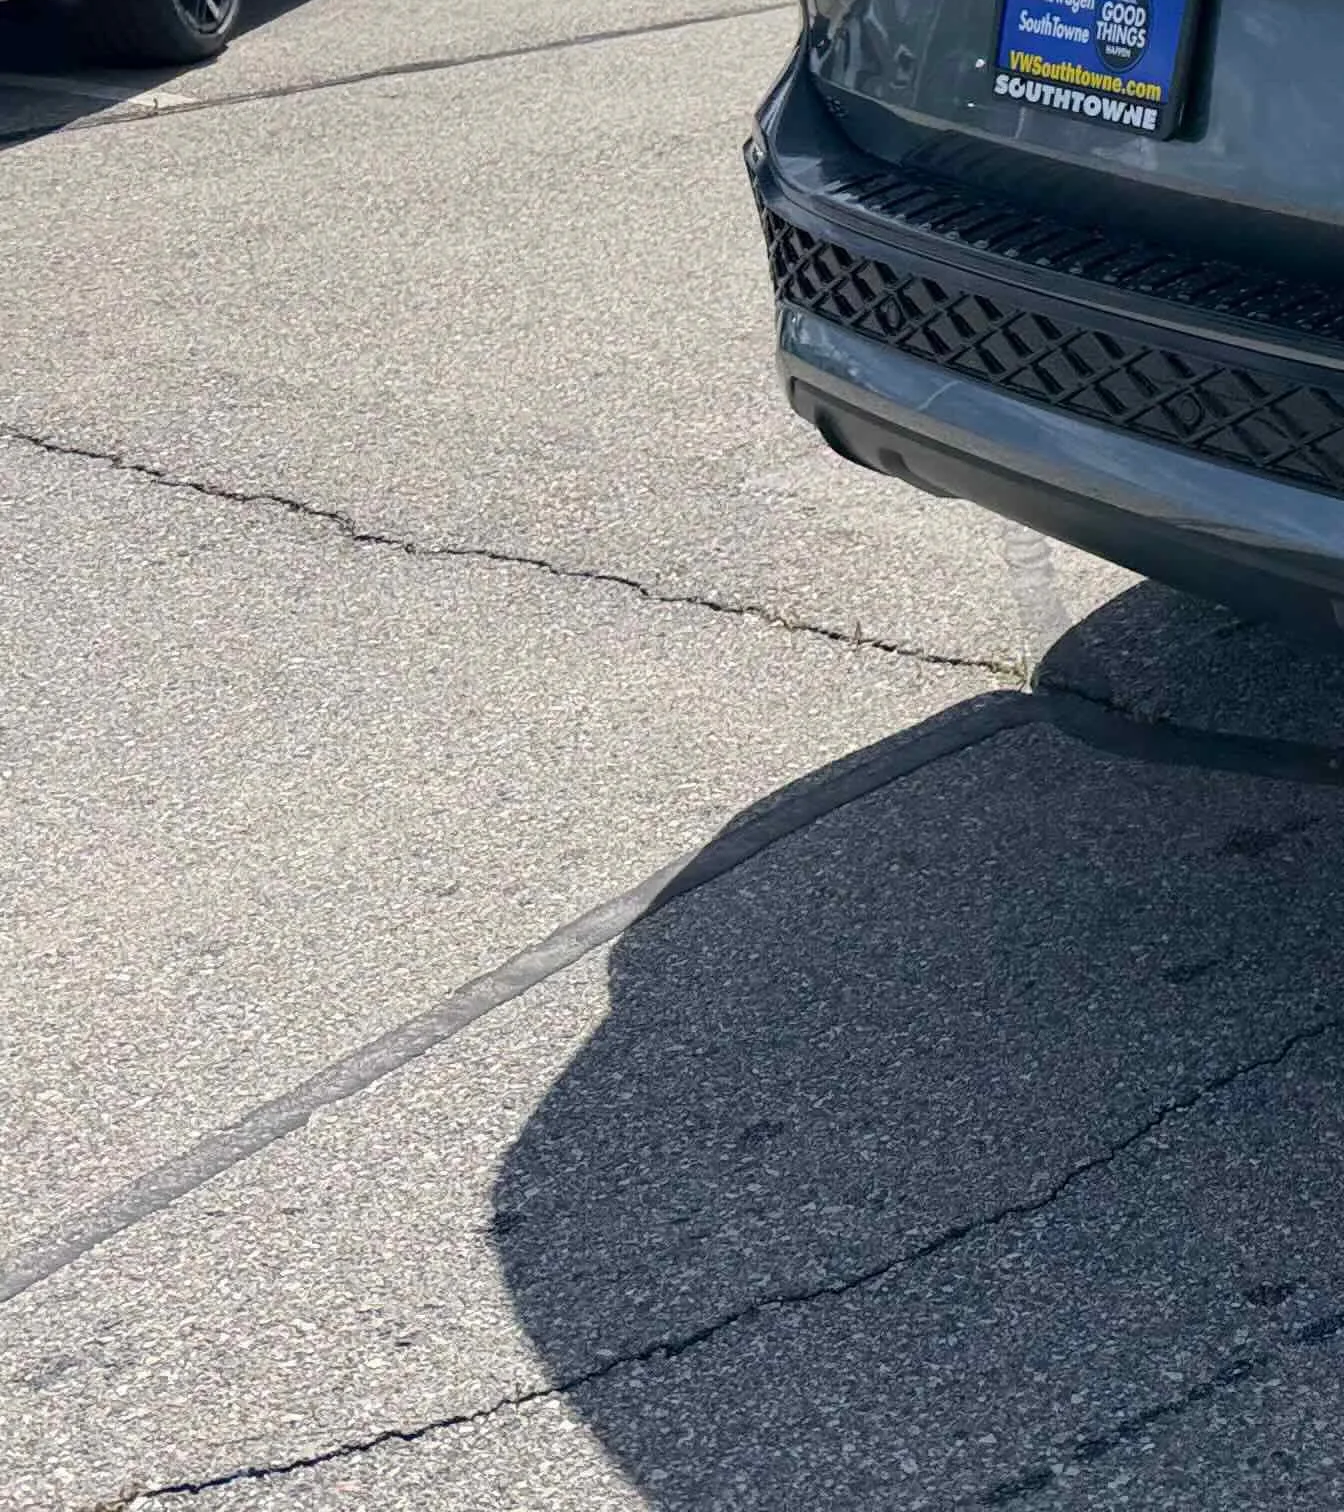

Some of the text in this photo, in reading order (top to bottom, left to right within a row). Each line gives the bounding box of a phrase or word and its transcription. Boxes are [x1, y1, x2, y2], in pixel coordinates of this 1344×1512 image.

[1018, 10, 1090, 44] SouthTowne
[1102, 1, 1147, 27] GOOD
[1096, 20, 1147, 49] THINGS
[1010, 50, 1162, 102] VWSouthtowne.com
[994, 74, 1158, 131] SOUTHTOWNE
